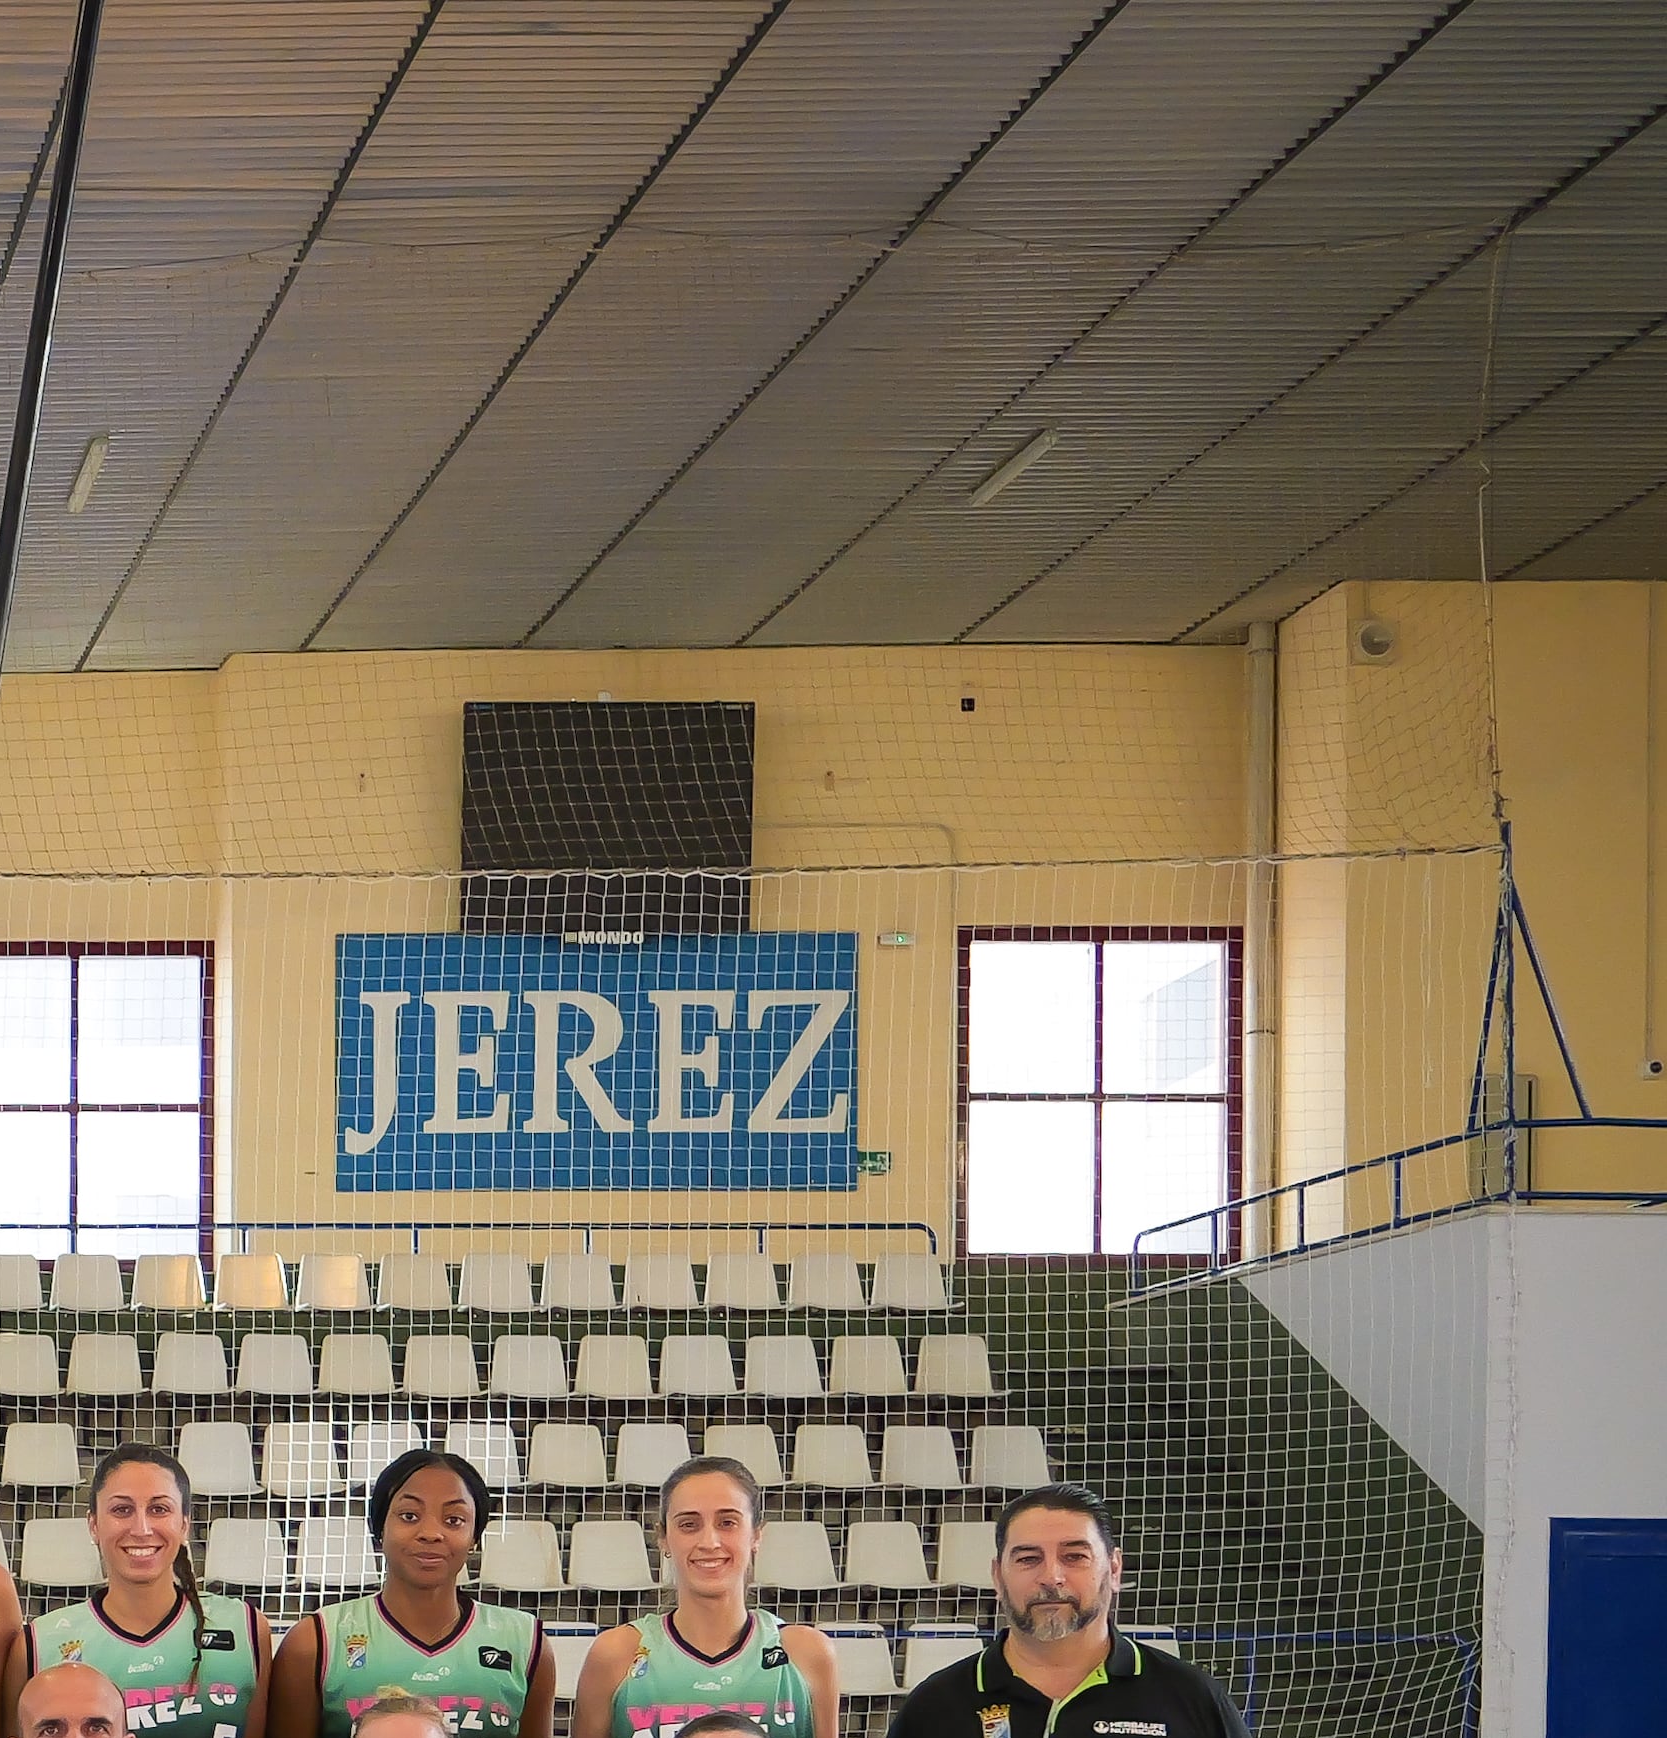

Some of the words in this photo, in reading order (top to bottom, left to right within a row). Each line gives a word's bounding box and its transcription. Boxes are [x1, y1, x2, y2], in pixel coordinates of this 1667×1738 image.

[578, 931, 644, 944] MONDO
[344, 990, 854, 1155] JEREZ
[124, 1683, 203, 1730] REZ
[1110, 1721, 1166, 1730] HERBALIFE
